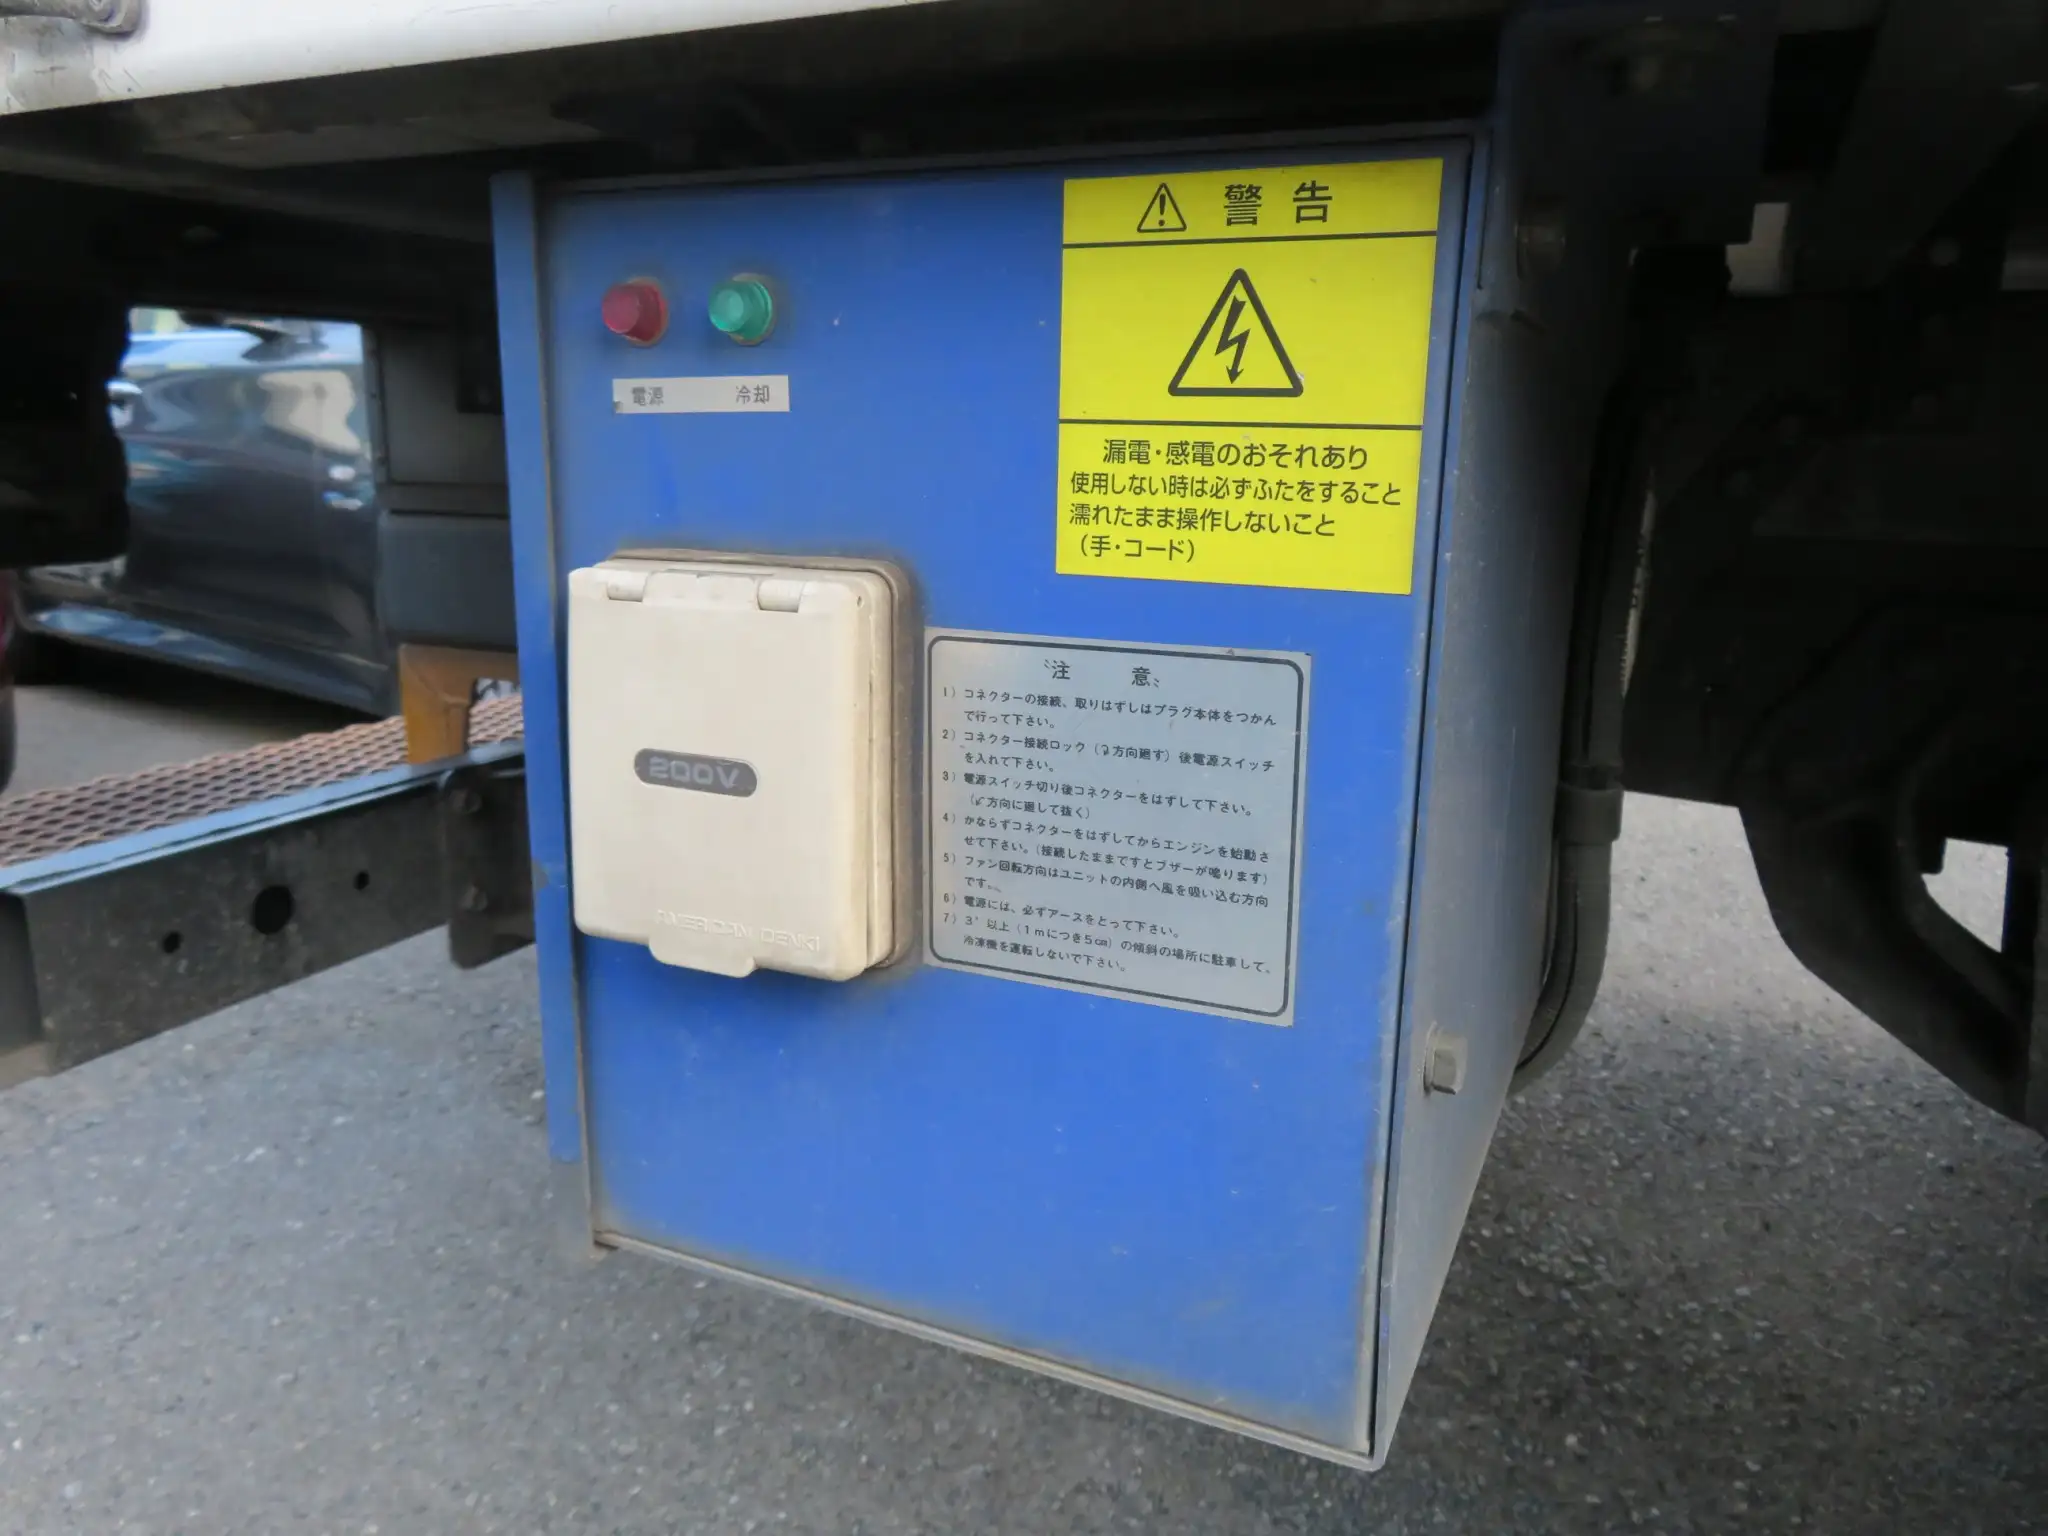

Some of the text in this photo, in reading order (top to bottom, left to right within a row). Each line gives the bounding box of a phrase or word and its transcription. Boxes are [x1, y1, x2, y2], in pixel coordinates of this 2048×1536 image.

[631, 385, 770, 407] 電源 冷却
[1102, 439, 1368, 470] 漏電・感電のおそれあり
[1070, 471, 1401, 506] 使用しない時は必ずふたをすること
[1068, 503, 1335, 537] 濡れたまま操作しないこと
[963, 709, 1055, 730] で行って下さい。
[649, 757, 740, 788] 200V
[963, 752, 1055, 773] を入れて下さい。
[760, 927, 821, 952] DENKI
